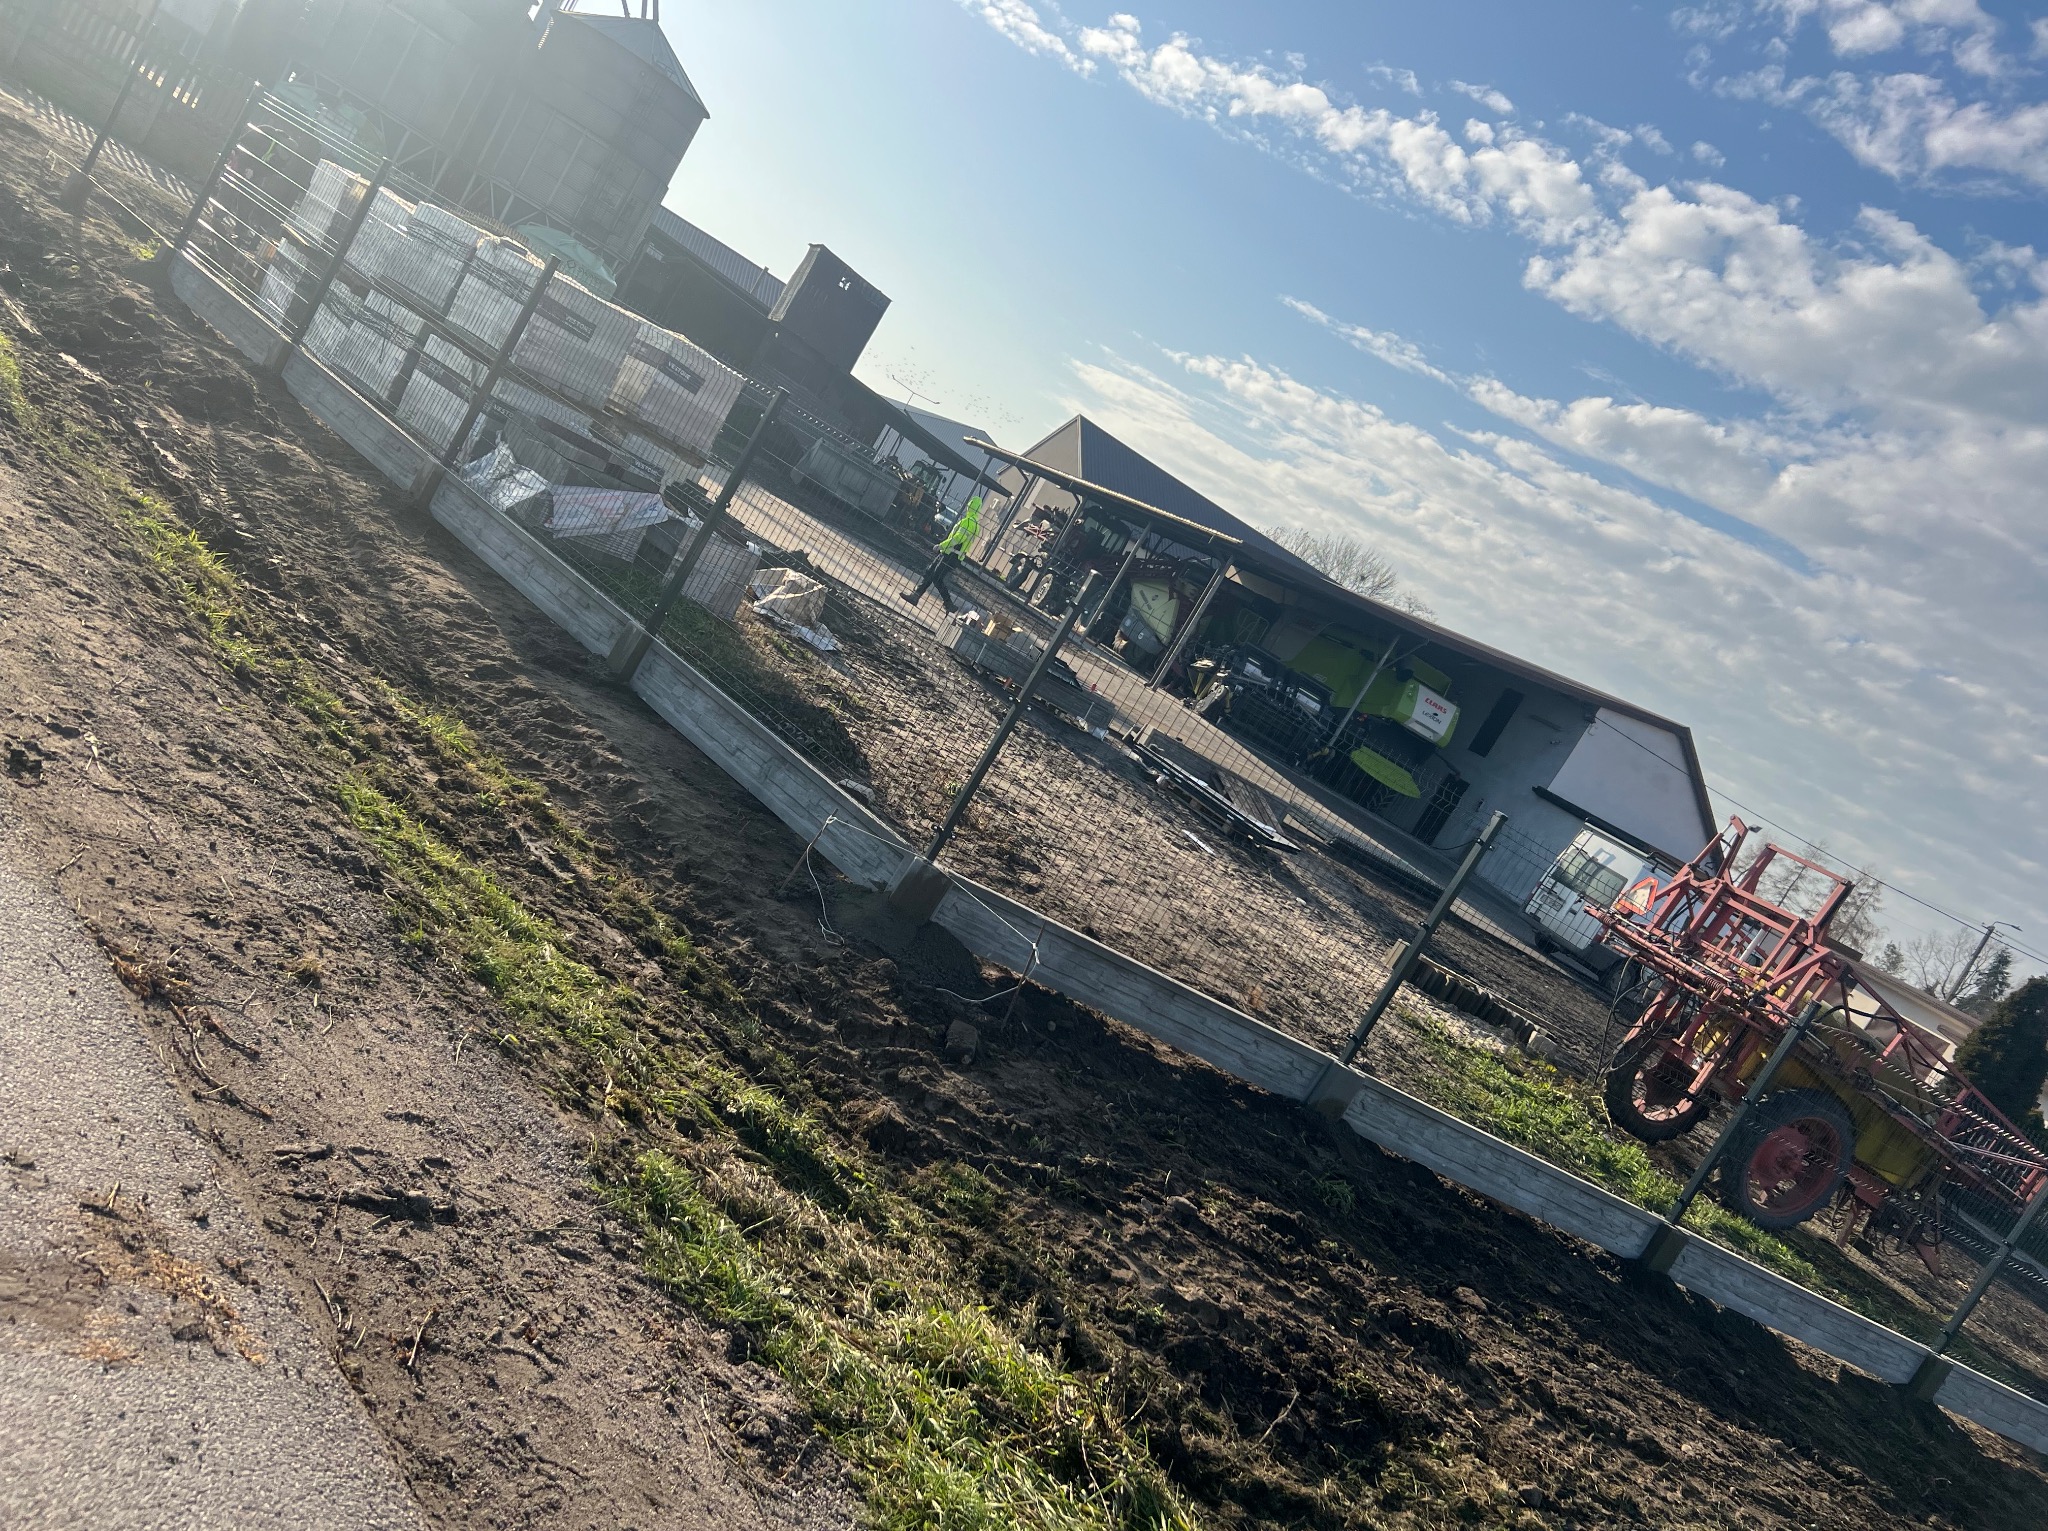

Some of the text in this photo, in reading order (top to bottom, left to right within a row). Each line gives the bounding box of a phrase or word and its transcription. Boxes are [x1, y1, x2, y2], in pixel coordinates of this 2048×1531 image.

[565, 315, 592, 334] VESTONE
[668, 361, 691, 380] VESTONE
[493, 404, 514, 418] VESTO
[1424, 697, 1447, 714] CLAAS
[1422, 710, 1442, 725] LEXION
